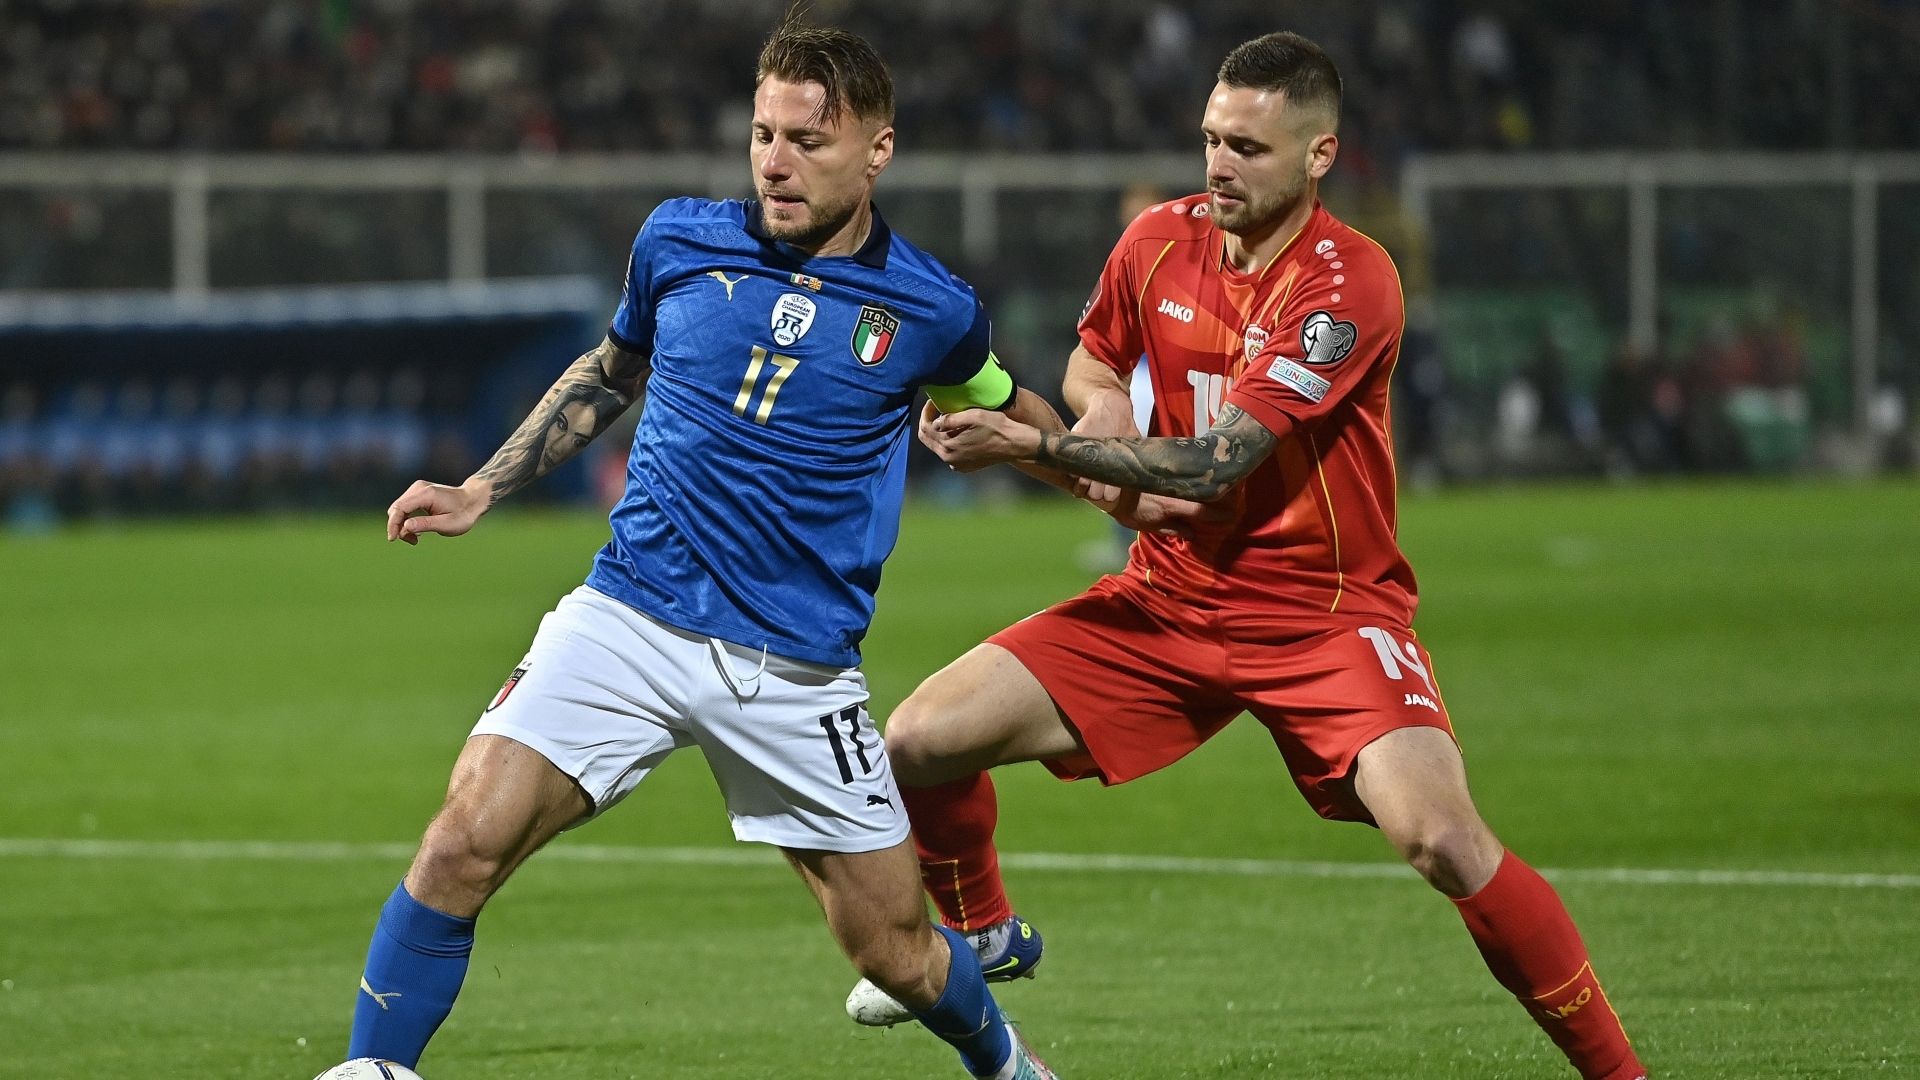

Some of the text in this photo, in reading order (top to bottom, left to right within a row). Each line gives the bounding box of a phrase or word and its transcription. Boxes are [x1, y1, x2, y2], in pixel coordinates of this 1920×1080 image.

[781, 304, 809, 317] CHAMPIONS
[783, 300, 811, 313] EUROPEAN
[1157, 298, 1194, 323] JAKO
[863, 310, 895, 331] ITALIA
[777, 333, 791, 342] 2020
[732, 344, 800, 425] 17
[1272, 362, 1326, 396] FOUNDATION
[1358, 626, 1437, 698] 14
[819, 704, 872, 785] 17
